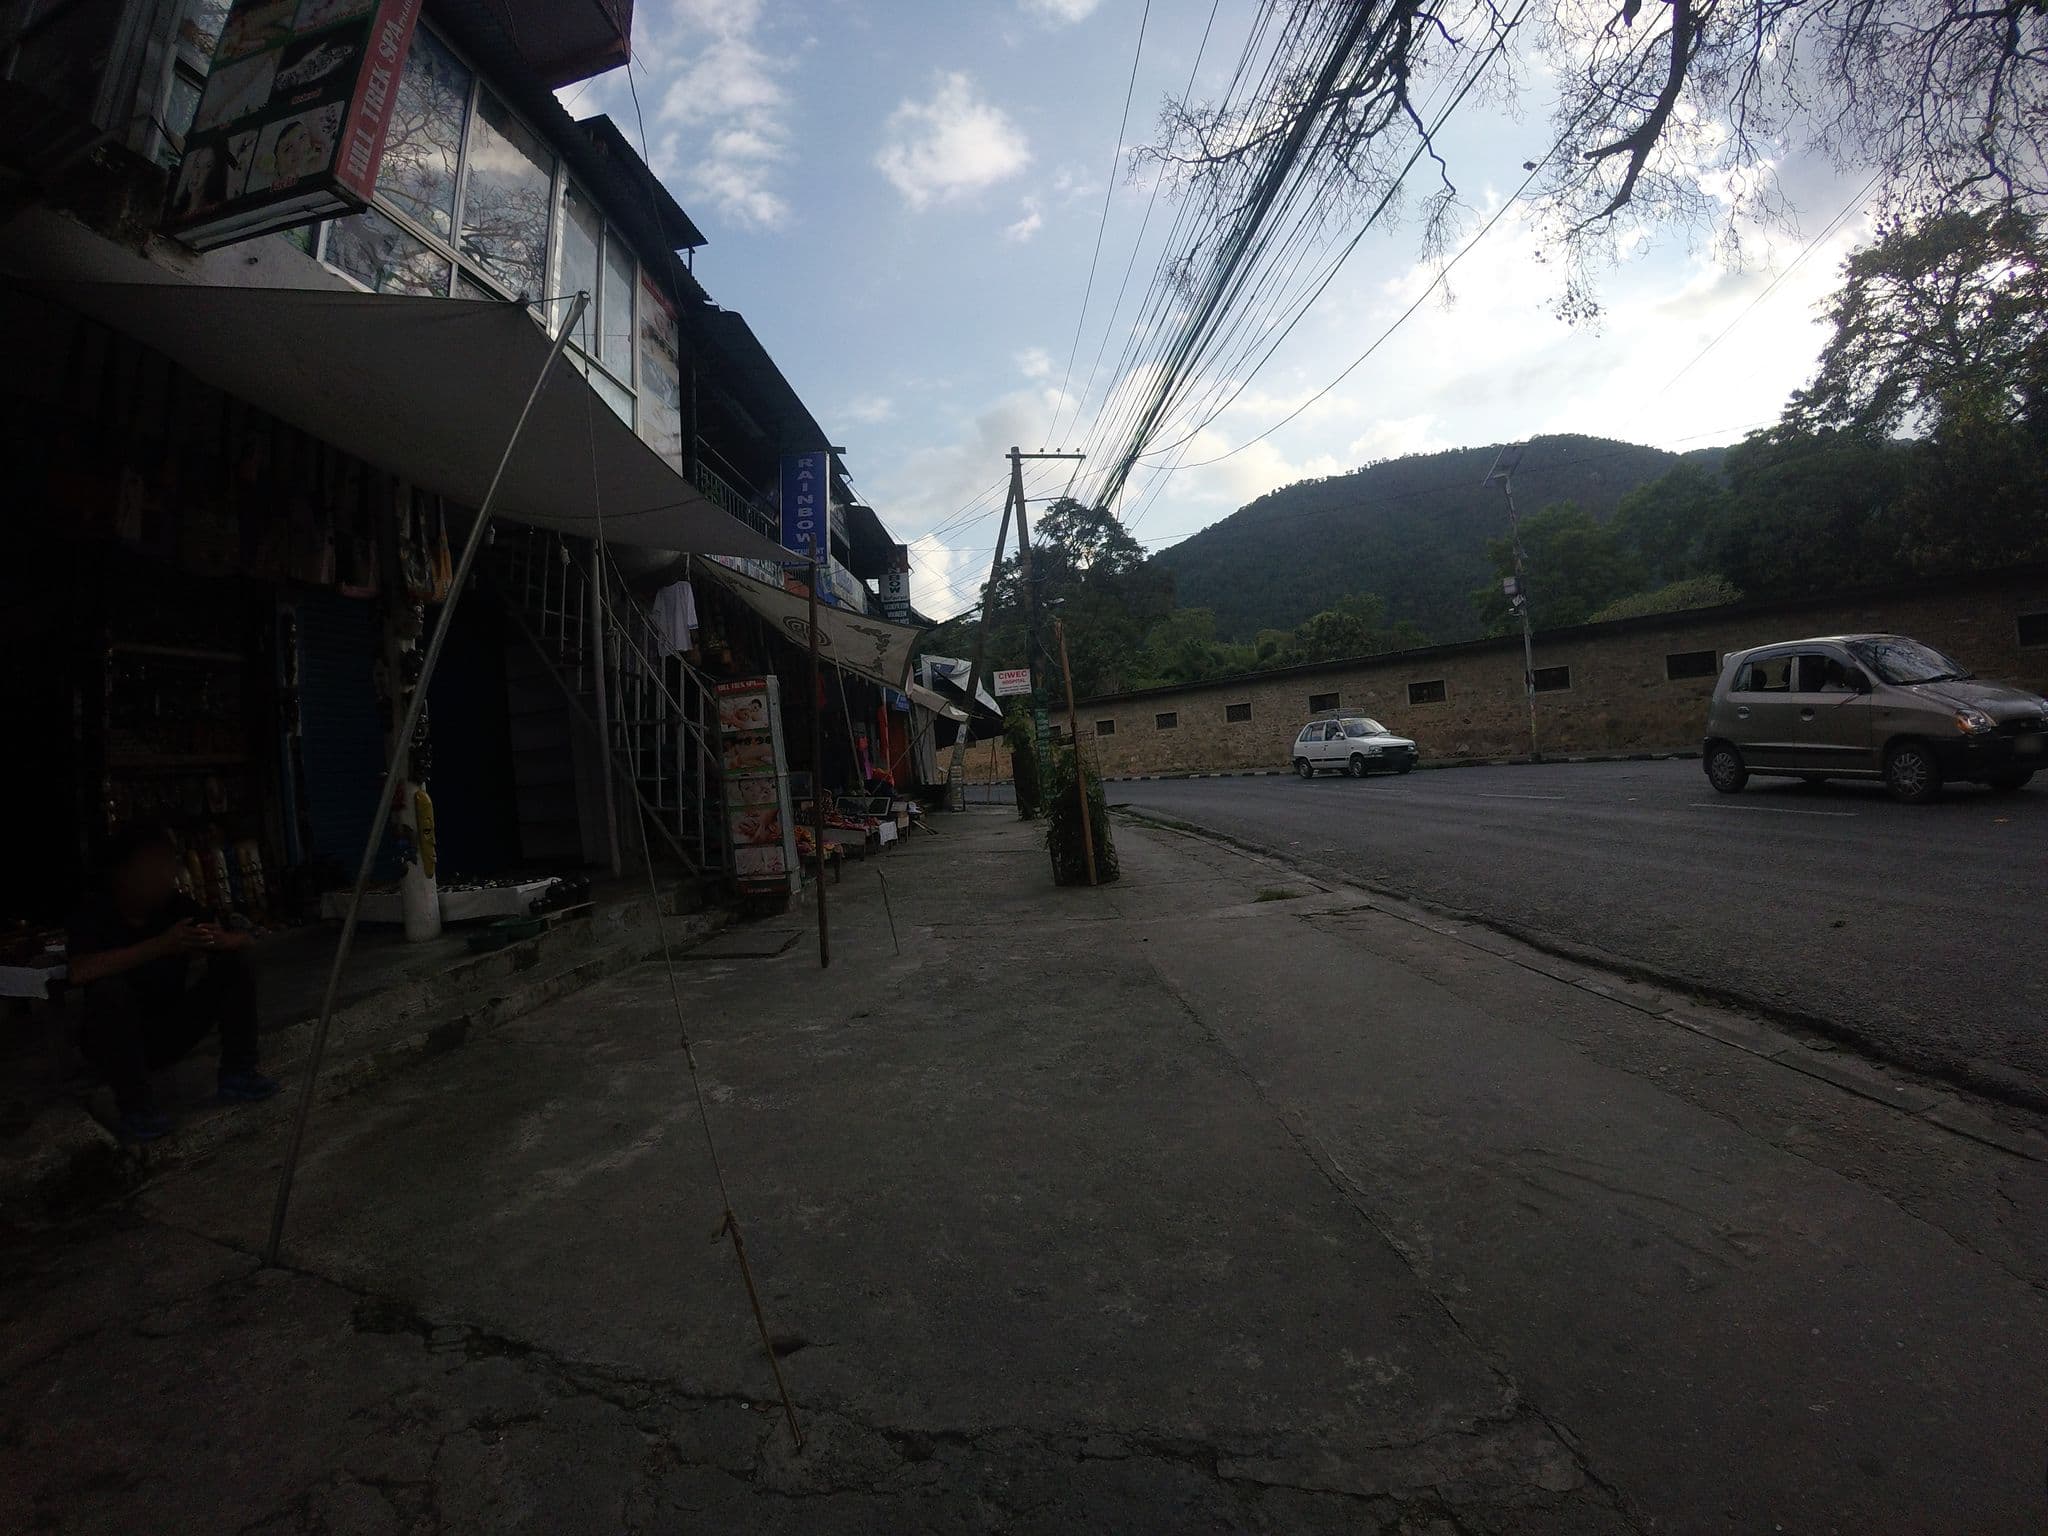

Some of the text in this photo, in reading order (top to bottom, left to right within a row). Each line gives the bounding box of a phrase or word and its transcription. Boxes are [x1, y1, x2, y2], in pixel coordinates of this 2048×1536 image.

[347, 19, 401, 181] HILL TREK SPA
[797, 458, 817, 543] RAINBOW
